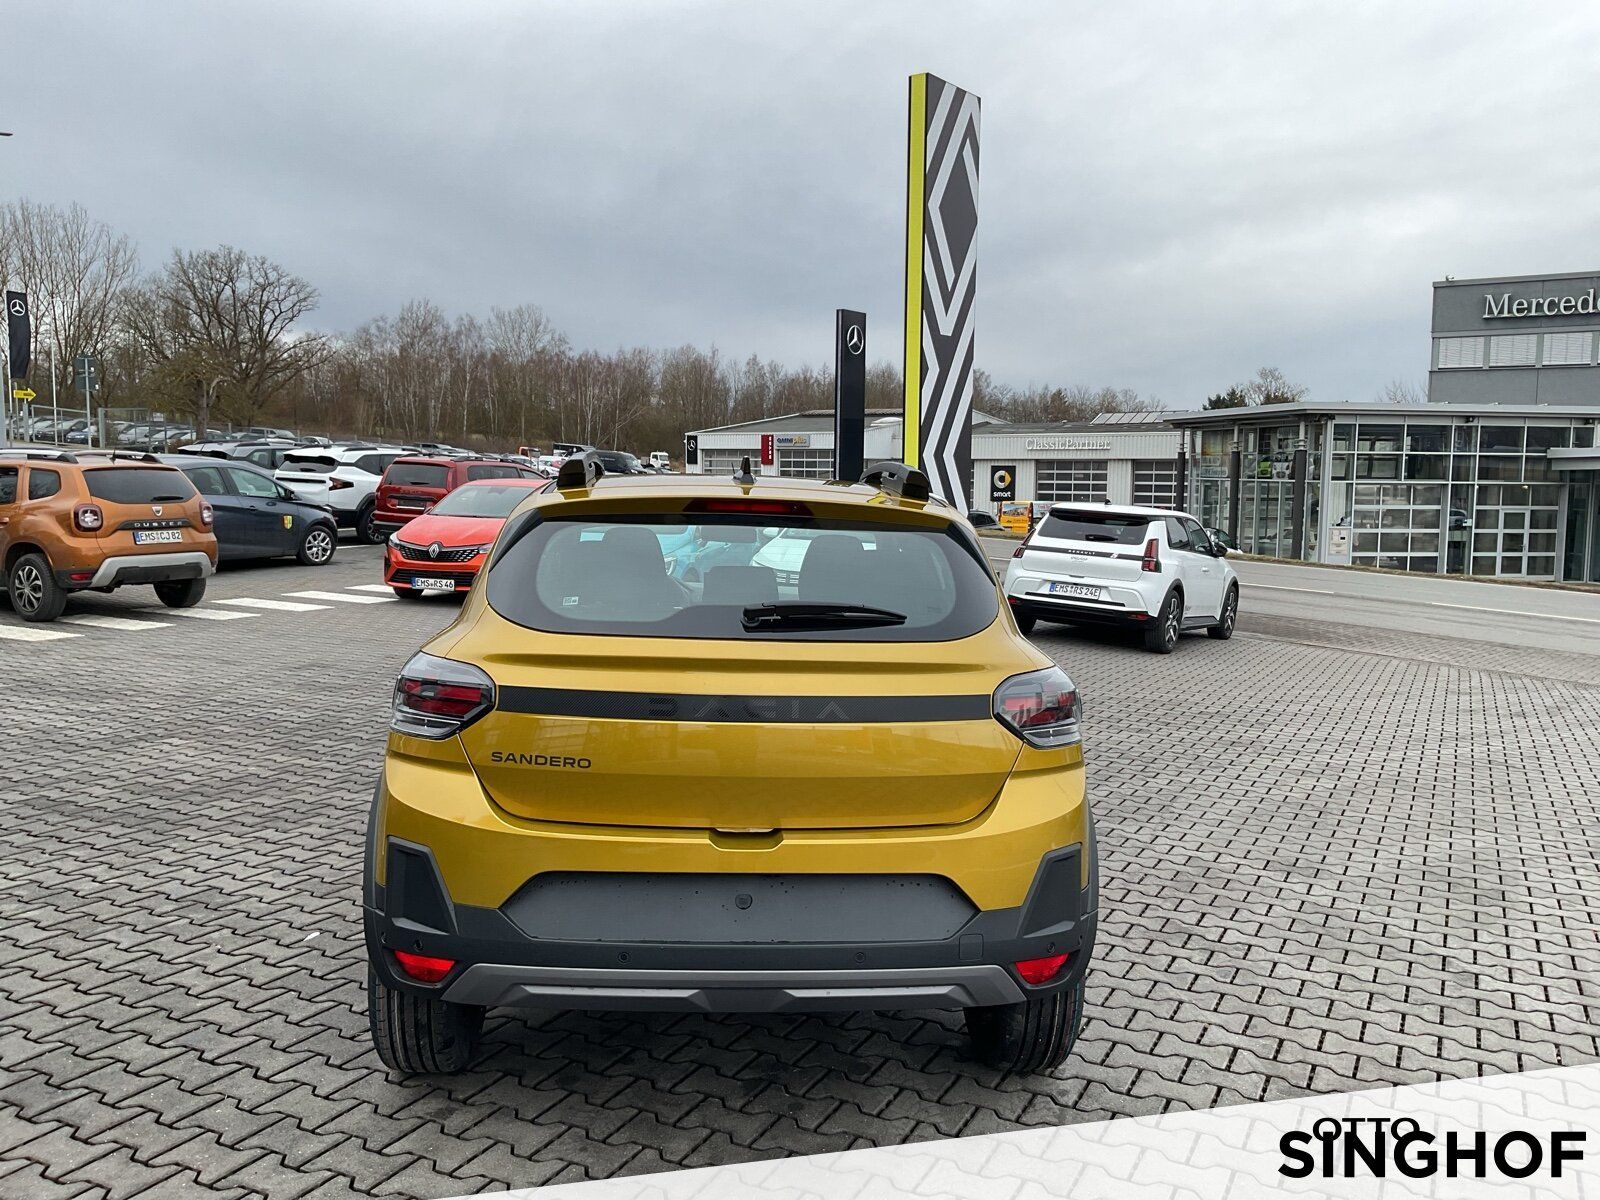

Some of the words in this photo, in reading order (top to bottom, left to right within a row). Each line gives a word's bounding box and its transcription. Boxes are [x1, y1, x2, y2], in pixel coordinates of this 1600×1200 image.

[1483, 288, 1600, 318] Merced
[140, 532, 156, 541] EMS
[172, 531, 181, 540] 82
[416, 579, 430, 587] EMS
[433, 580, 445, 588] RS
[444, 580, 454, 588] 46
[1055, 584, 1070, 593] EMS
[1074, 587, 1084, 595] RS
[1084, 587, 1099, 597] 24E
[491, 751, 592, 769] SANDERO
